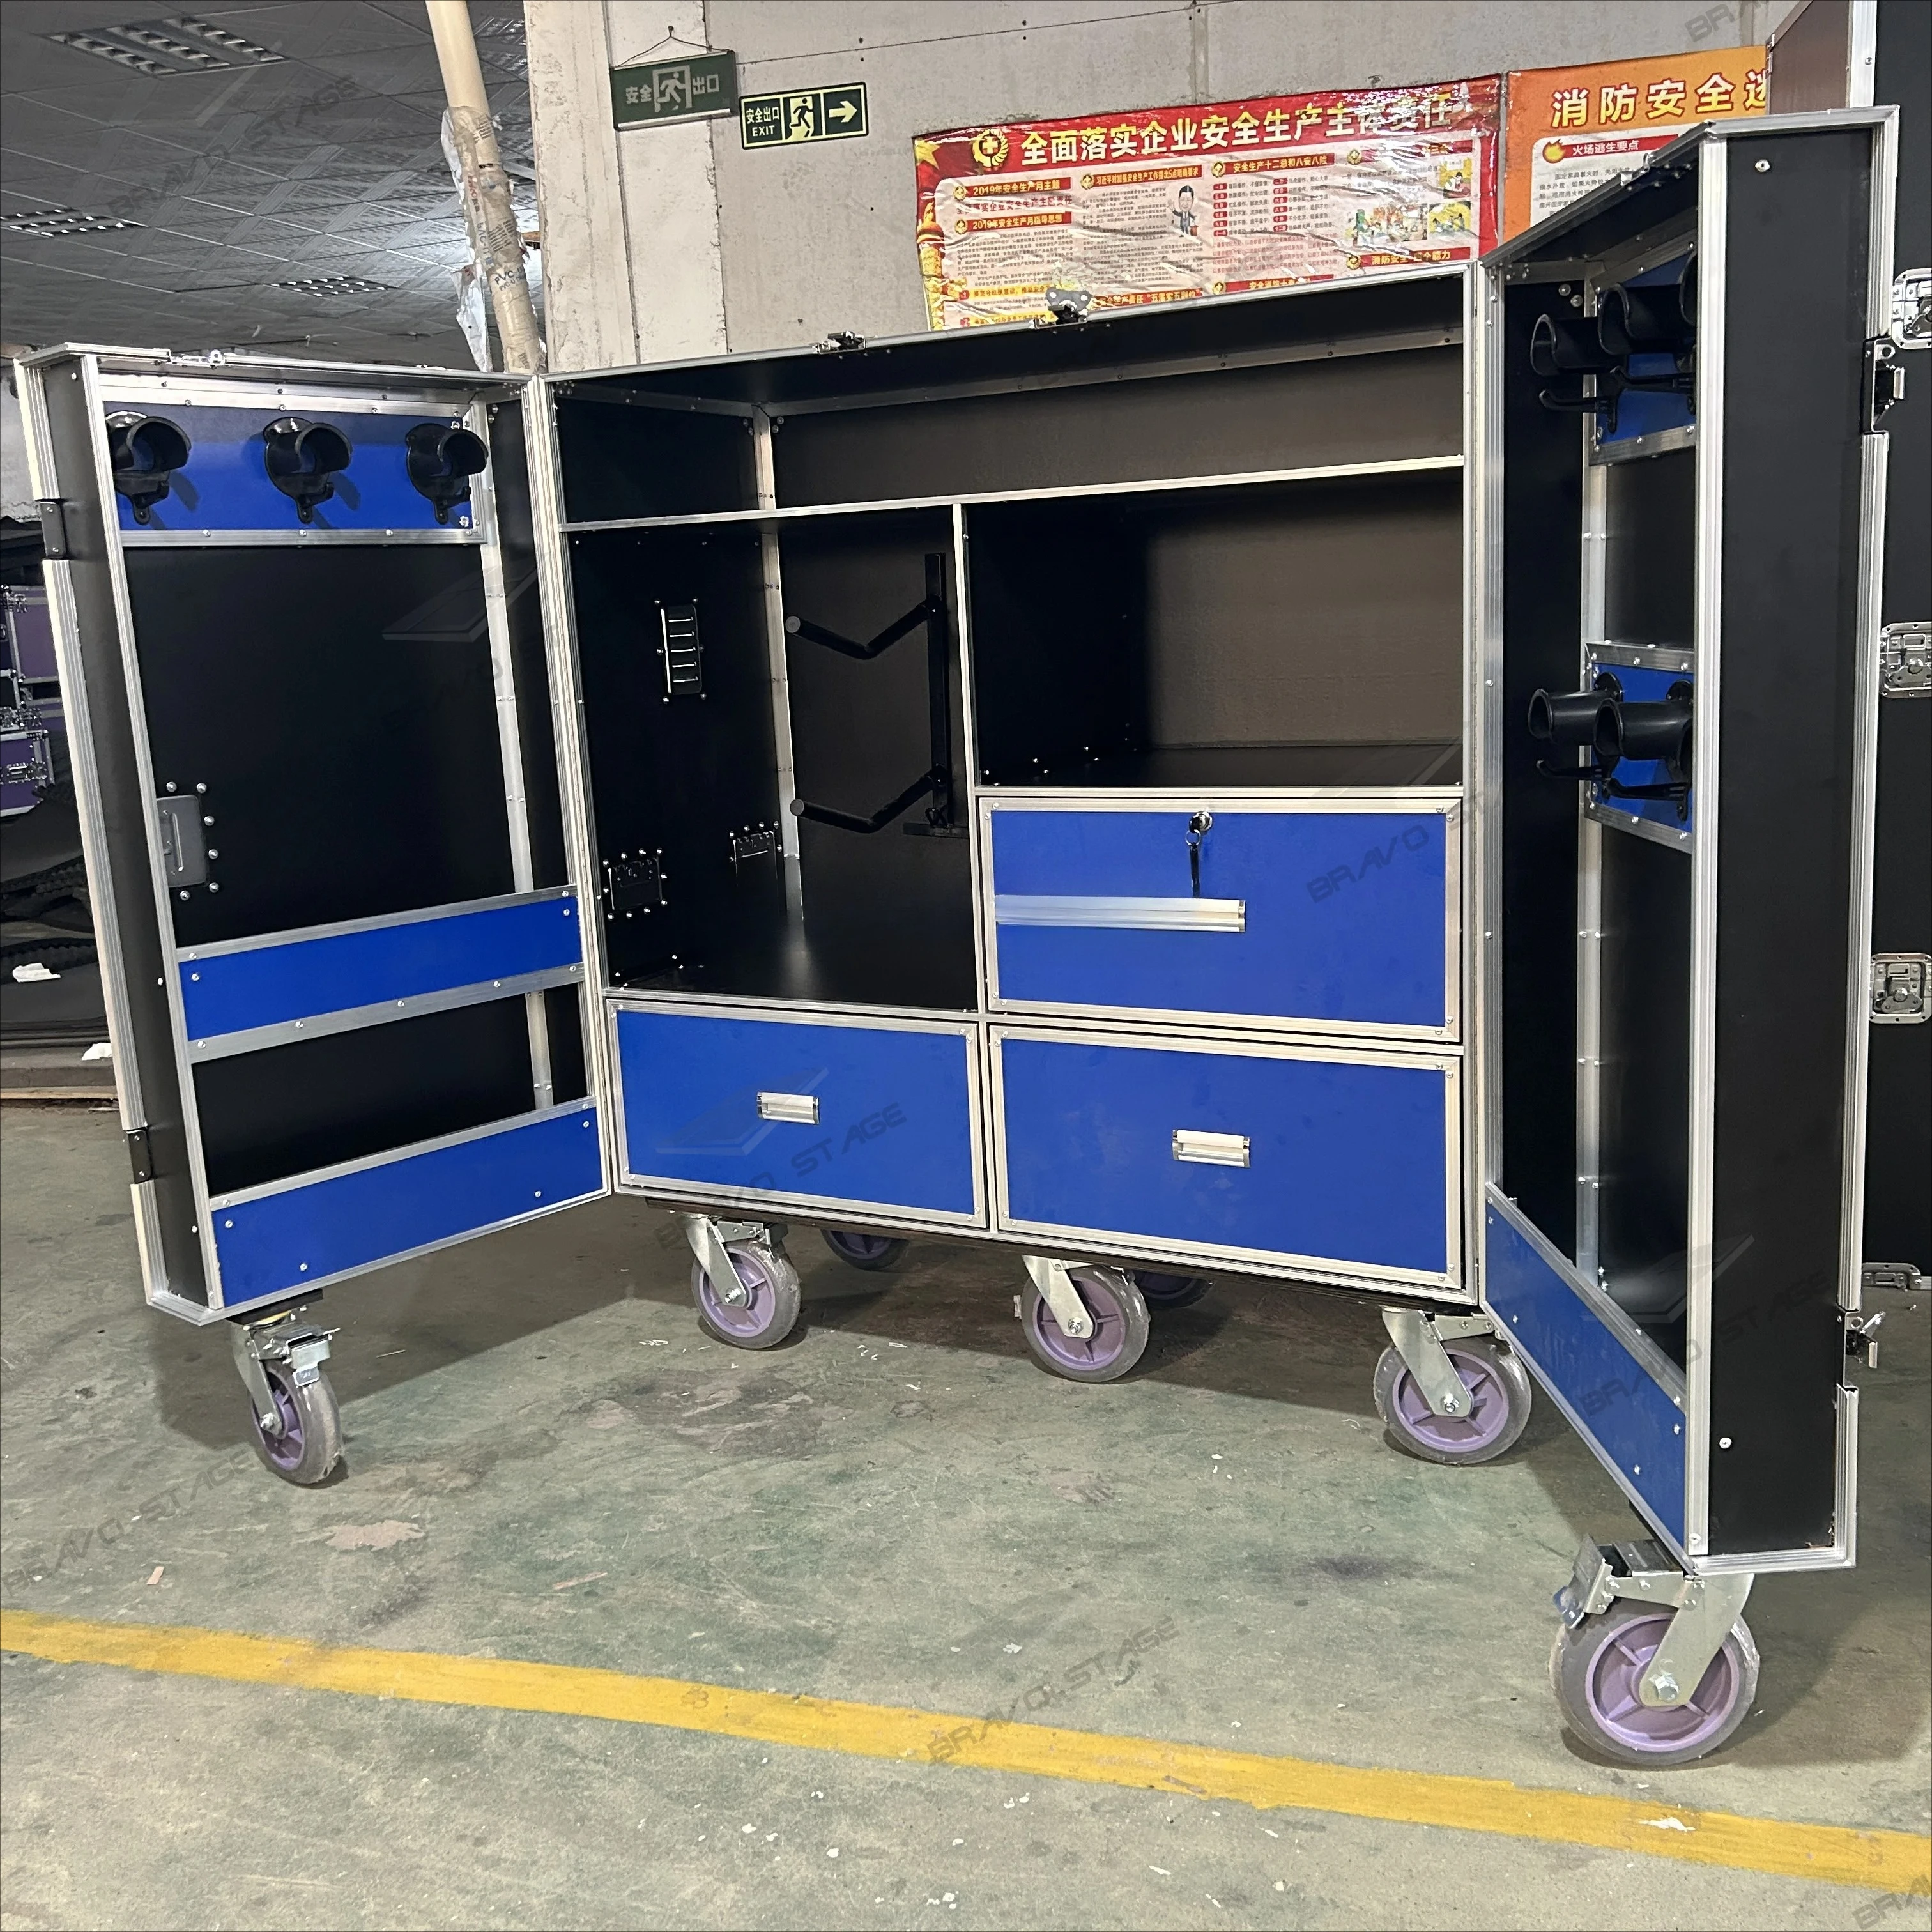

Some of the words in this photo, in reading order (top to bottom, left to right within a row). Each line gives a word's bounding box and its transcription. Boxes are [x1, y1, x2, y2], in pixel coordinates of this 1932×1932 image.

[626, 84, 652, 104] 安全
[693, 74, 719, 95] 出口
[746, 105, 779, 125] 安全出口
[751, 125, 775, 137] EXIT
[1572, 139, 1639, 156] 火场逃生要点
[973, 179, 1061, 196] 2019年安全生产月主题
[957, 194, 1073, 215] 全落实企业安全生产主责任
